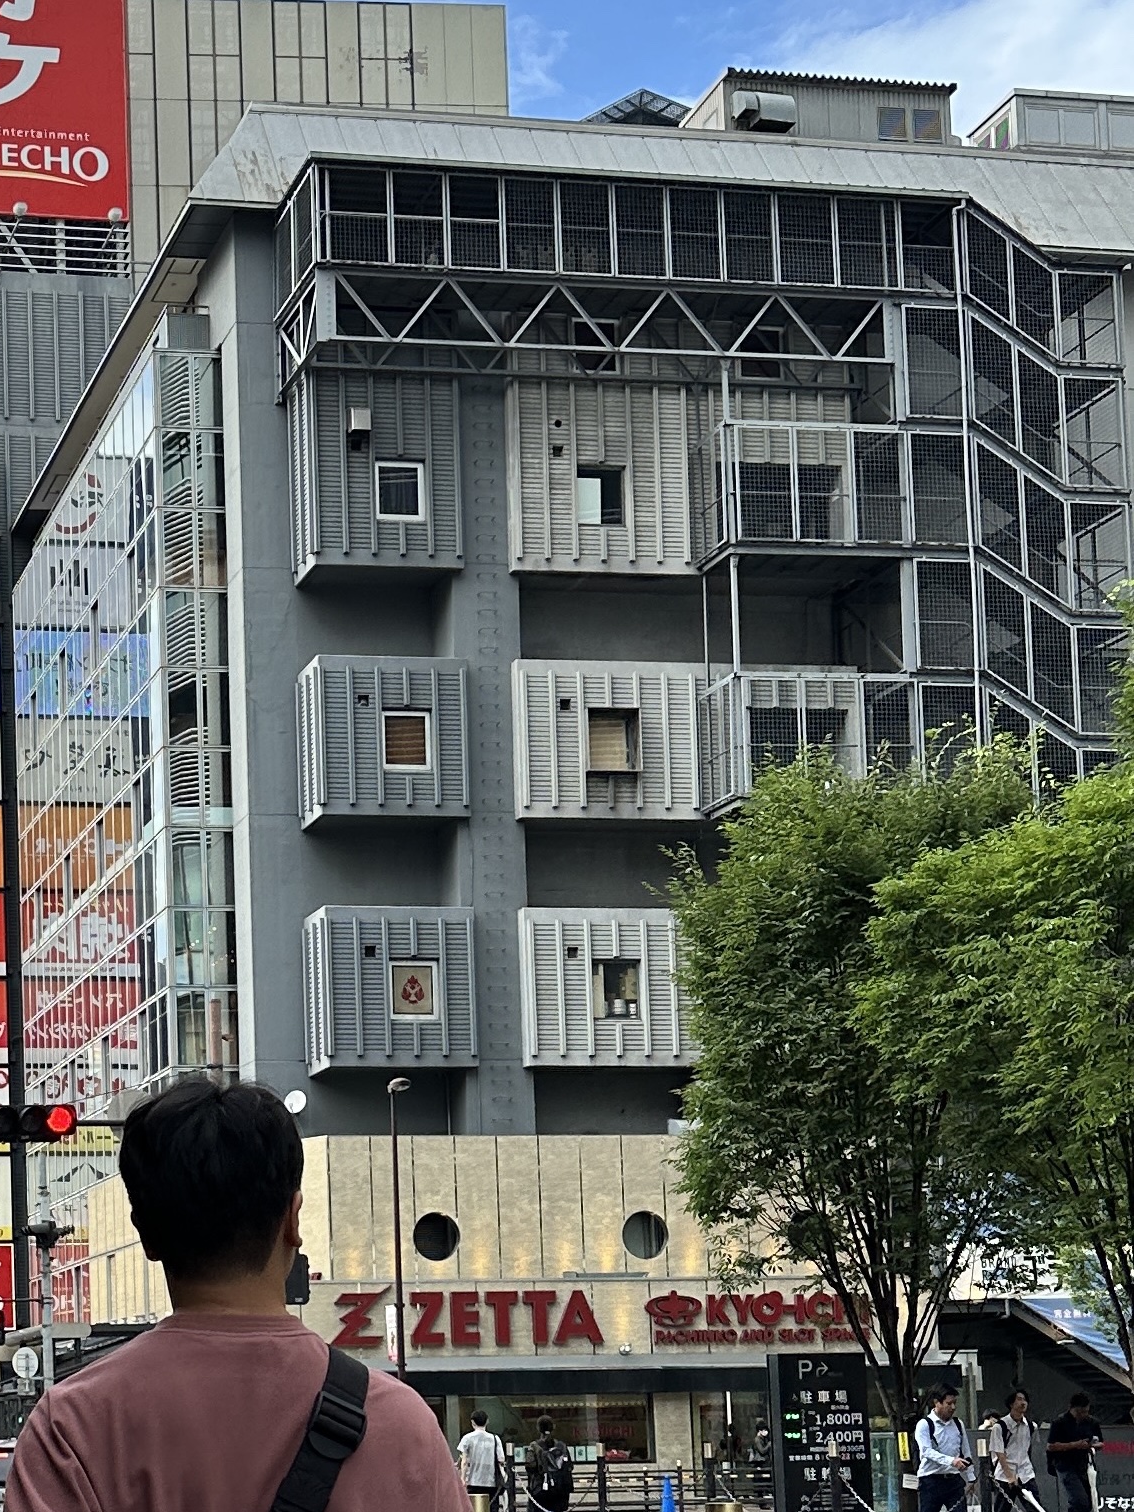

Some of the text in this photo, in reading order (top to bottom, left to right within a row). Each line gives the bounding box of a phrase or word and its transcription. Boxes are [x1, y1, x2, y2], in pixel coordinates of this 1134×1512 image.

[1, 142, 110, 182] ECHO
[409, 1289, 605, 1349] ZETTA
[798, 1359, 813, 1380] P
[799, 1389, 848, 1404] 駐車場
[815, 1412, 864, 1428] 1,800円
[815, 1430, 864, 1445] 2,400円
